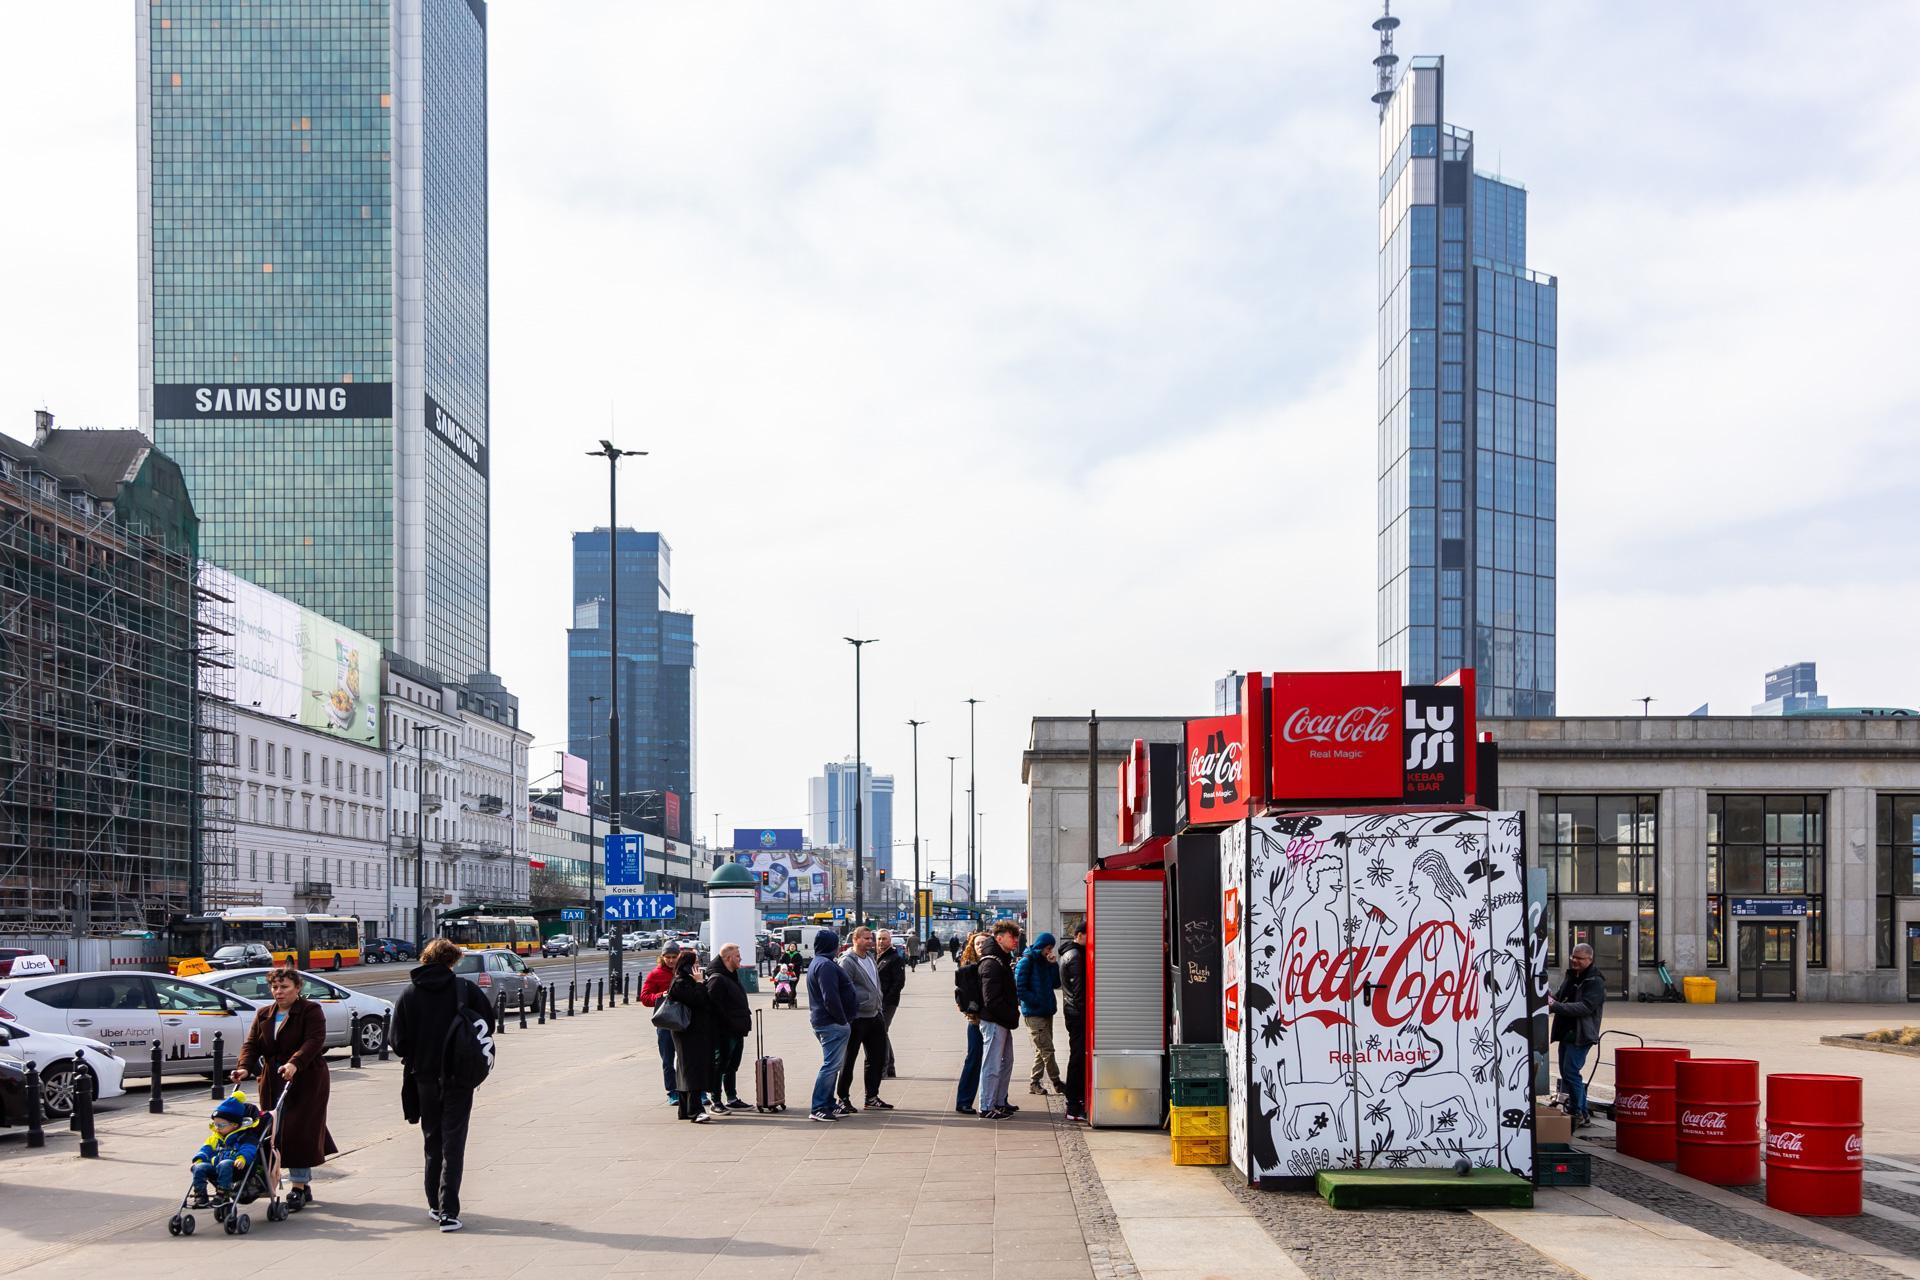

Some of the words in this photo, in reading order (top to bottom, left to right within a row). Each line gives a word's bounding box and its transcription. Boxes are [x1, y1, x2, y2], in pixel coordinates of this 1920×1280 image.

[195, 388, 347, 412] SAMSUNG
[435, 407, 479, 463] SAMSUNG
[1282, 706, 1396, 743] Coca-Cola
[1309, 750, 1331, 758] Real
[1407, 772, 1445, 781] KEBAB
[1407, 783, 1415, 791] &
[1417, 782, 1440, 791] BAR
[612, 886, 637, 894] Koniec
[562, 911, 583, 920] TAXI
[835, 908, 843, 918] P
[20, 959, 47, 970] Uber
[1279, 919, 1481, 1029] Coca-Cola
[100, 1028, 124, 1038] Uber
[125, 1027, 155, 1039] Airport
[1329, 1050, 1372, 1064] Real
[1681, 1110, 1728, 1128] Coca-Cola
